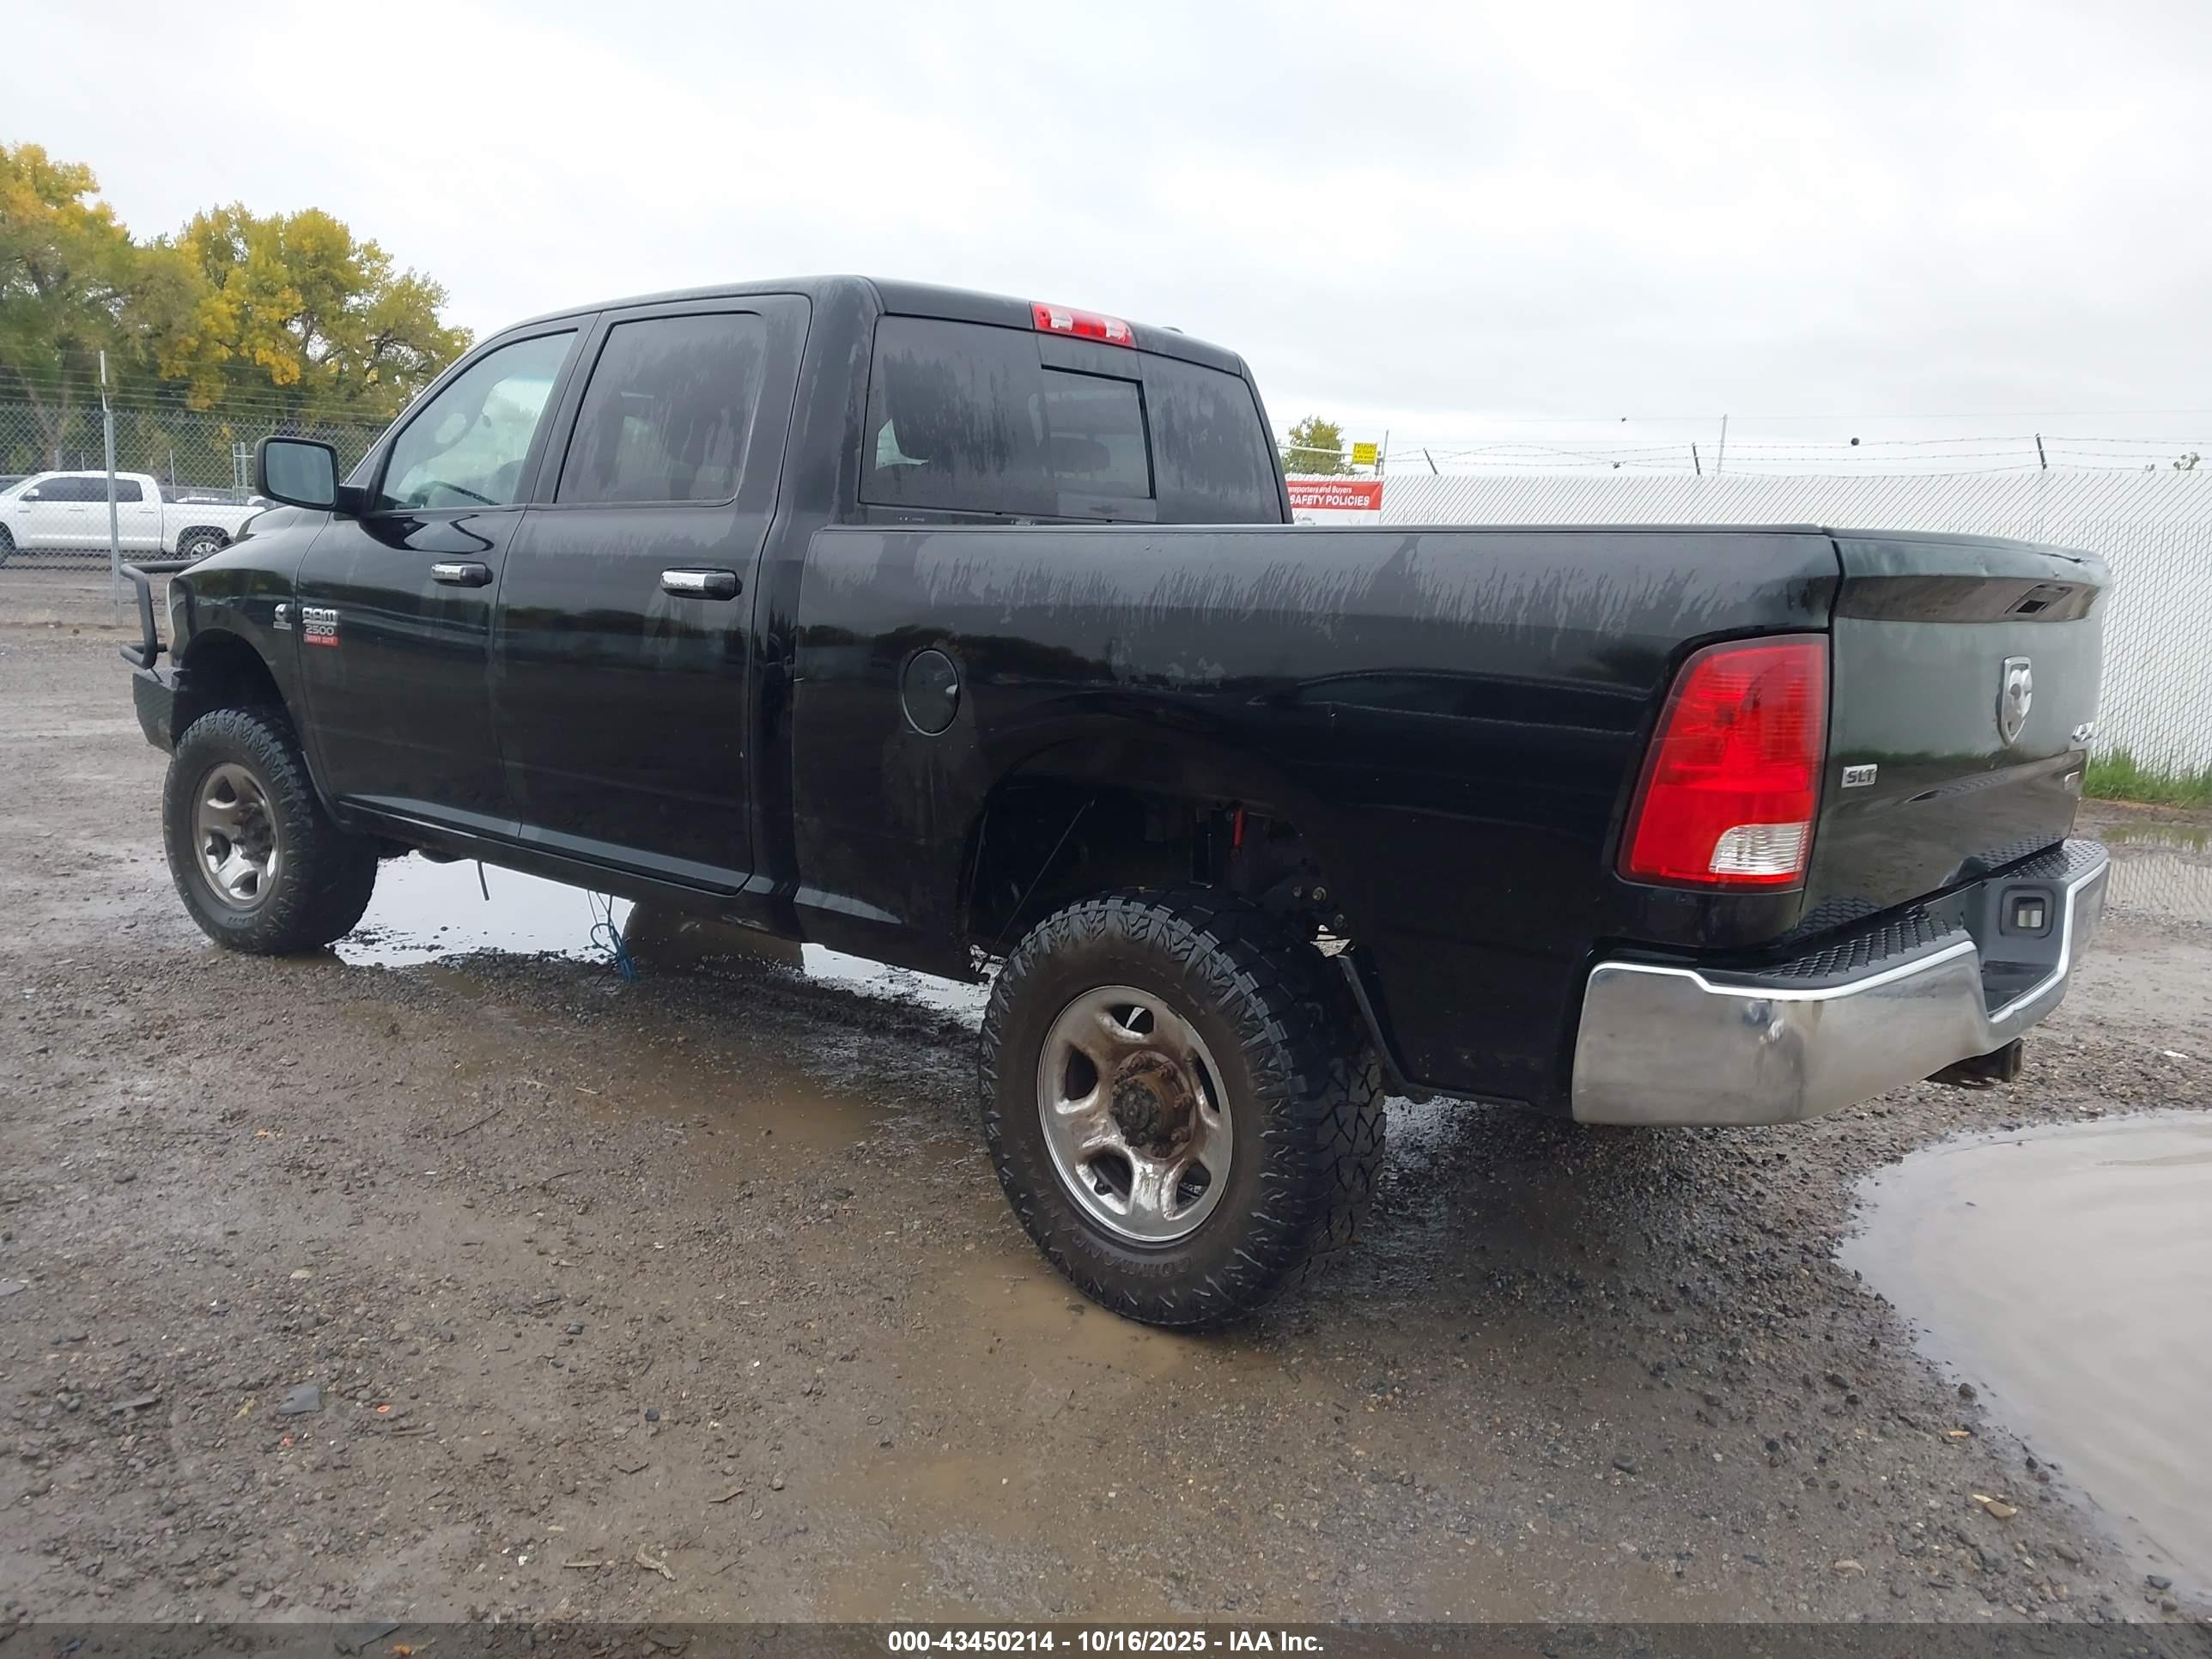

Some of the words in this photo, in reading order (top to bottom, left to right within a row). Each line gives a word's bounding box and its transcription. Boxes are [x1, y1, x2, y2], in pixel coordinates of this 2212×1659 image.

[1332, 484, 1352, 495] Buyers
[1291, 494, 1324, 505] SAFETY
[1325, 495, 1370, 507] POLICIES
[302, 607, 338, 626] RAM
[306, 624, 334, 635] 2500
[1847, 767, 1876, 784] SLT
